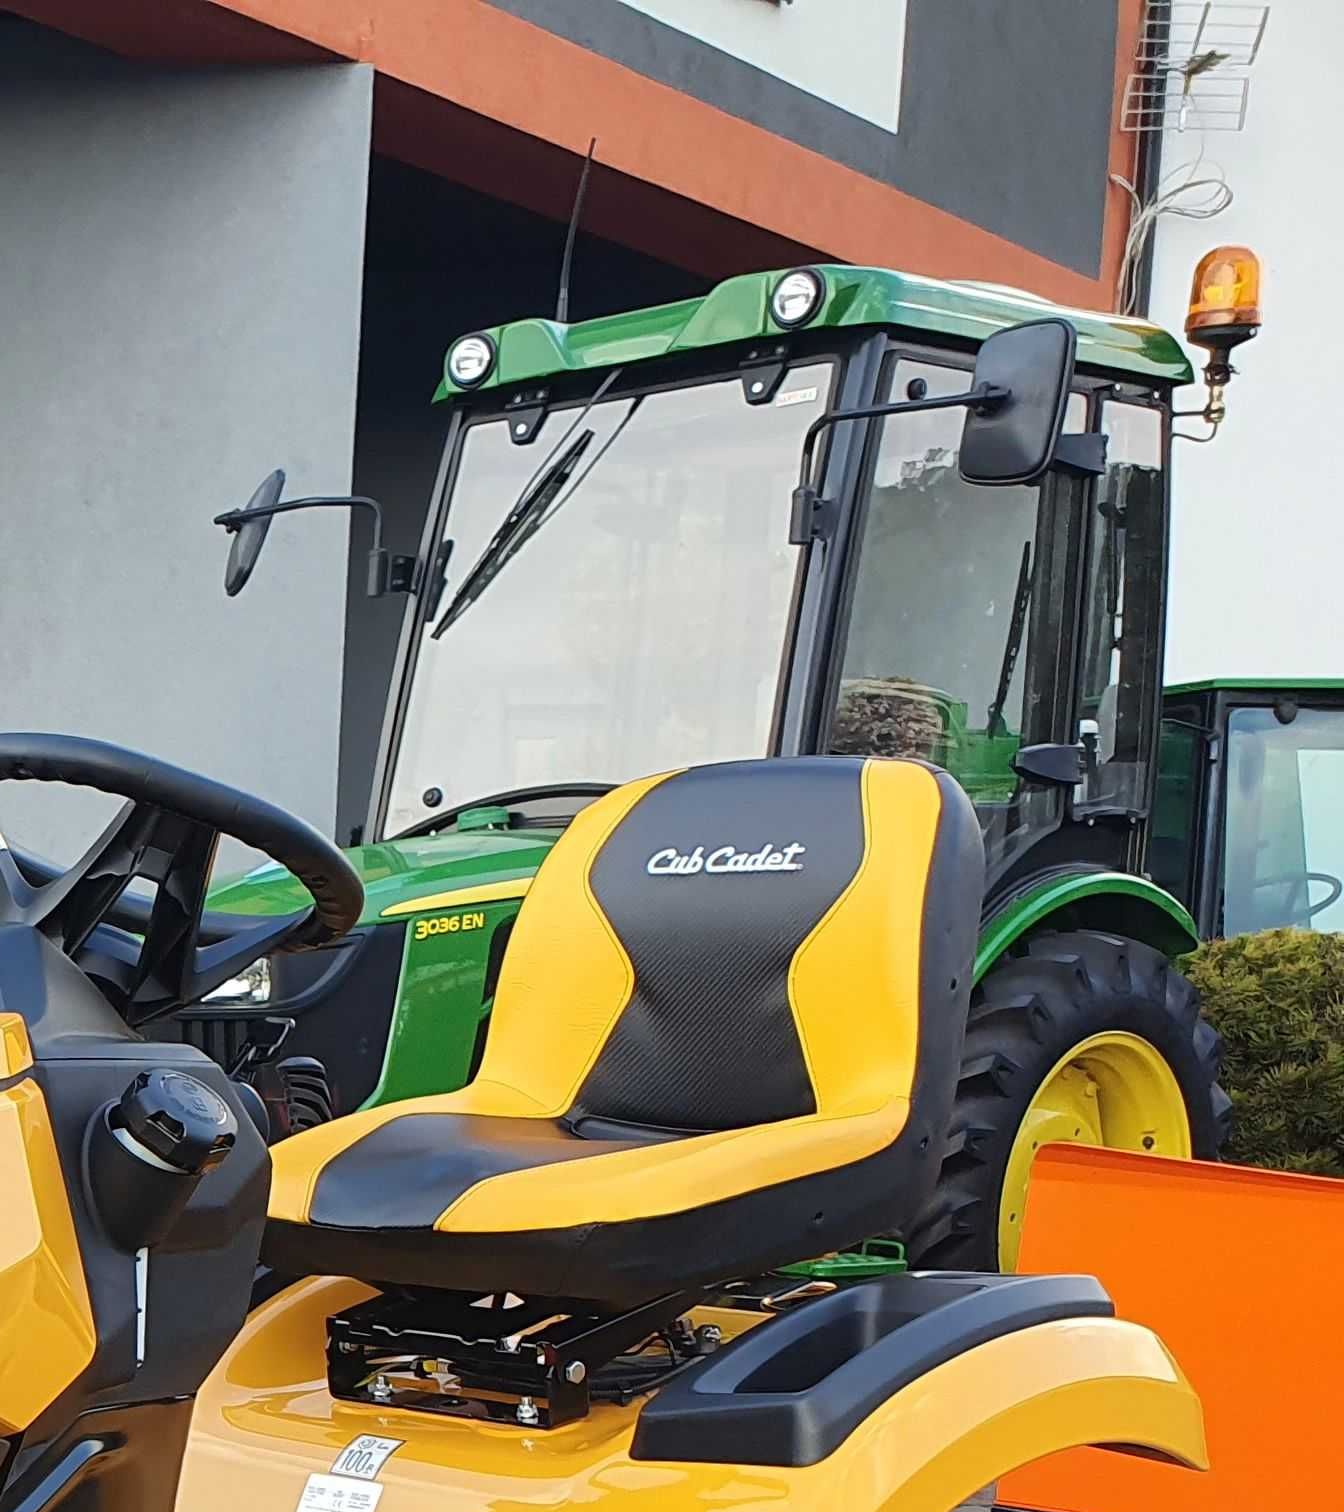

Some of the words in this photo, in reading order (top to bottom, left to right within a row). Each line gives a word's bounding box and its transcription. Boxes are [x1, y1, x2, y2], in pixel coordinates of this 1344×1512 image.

[647, 846, 704, 875] Cub
[705, 842, 806, 873] Cadet
[415, 914, 460, 941] 3036
[462, 912, 485, 930] EN
